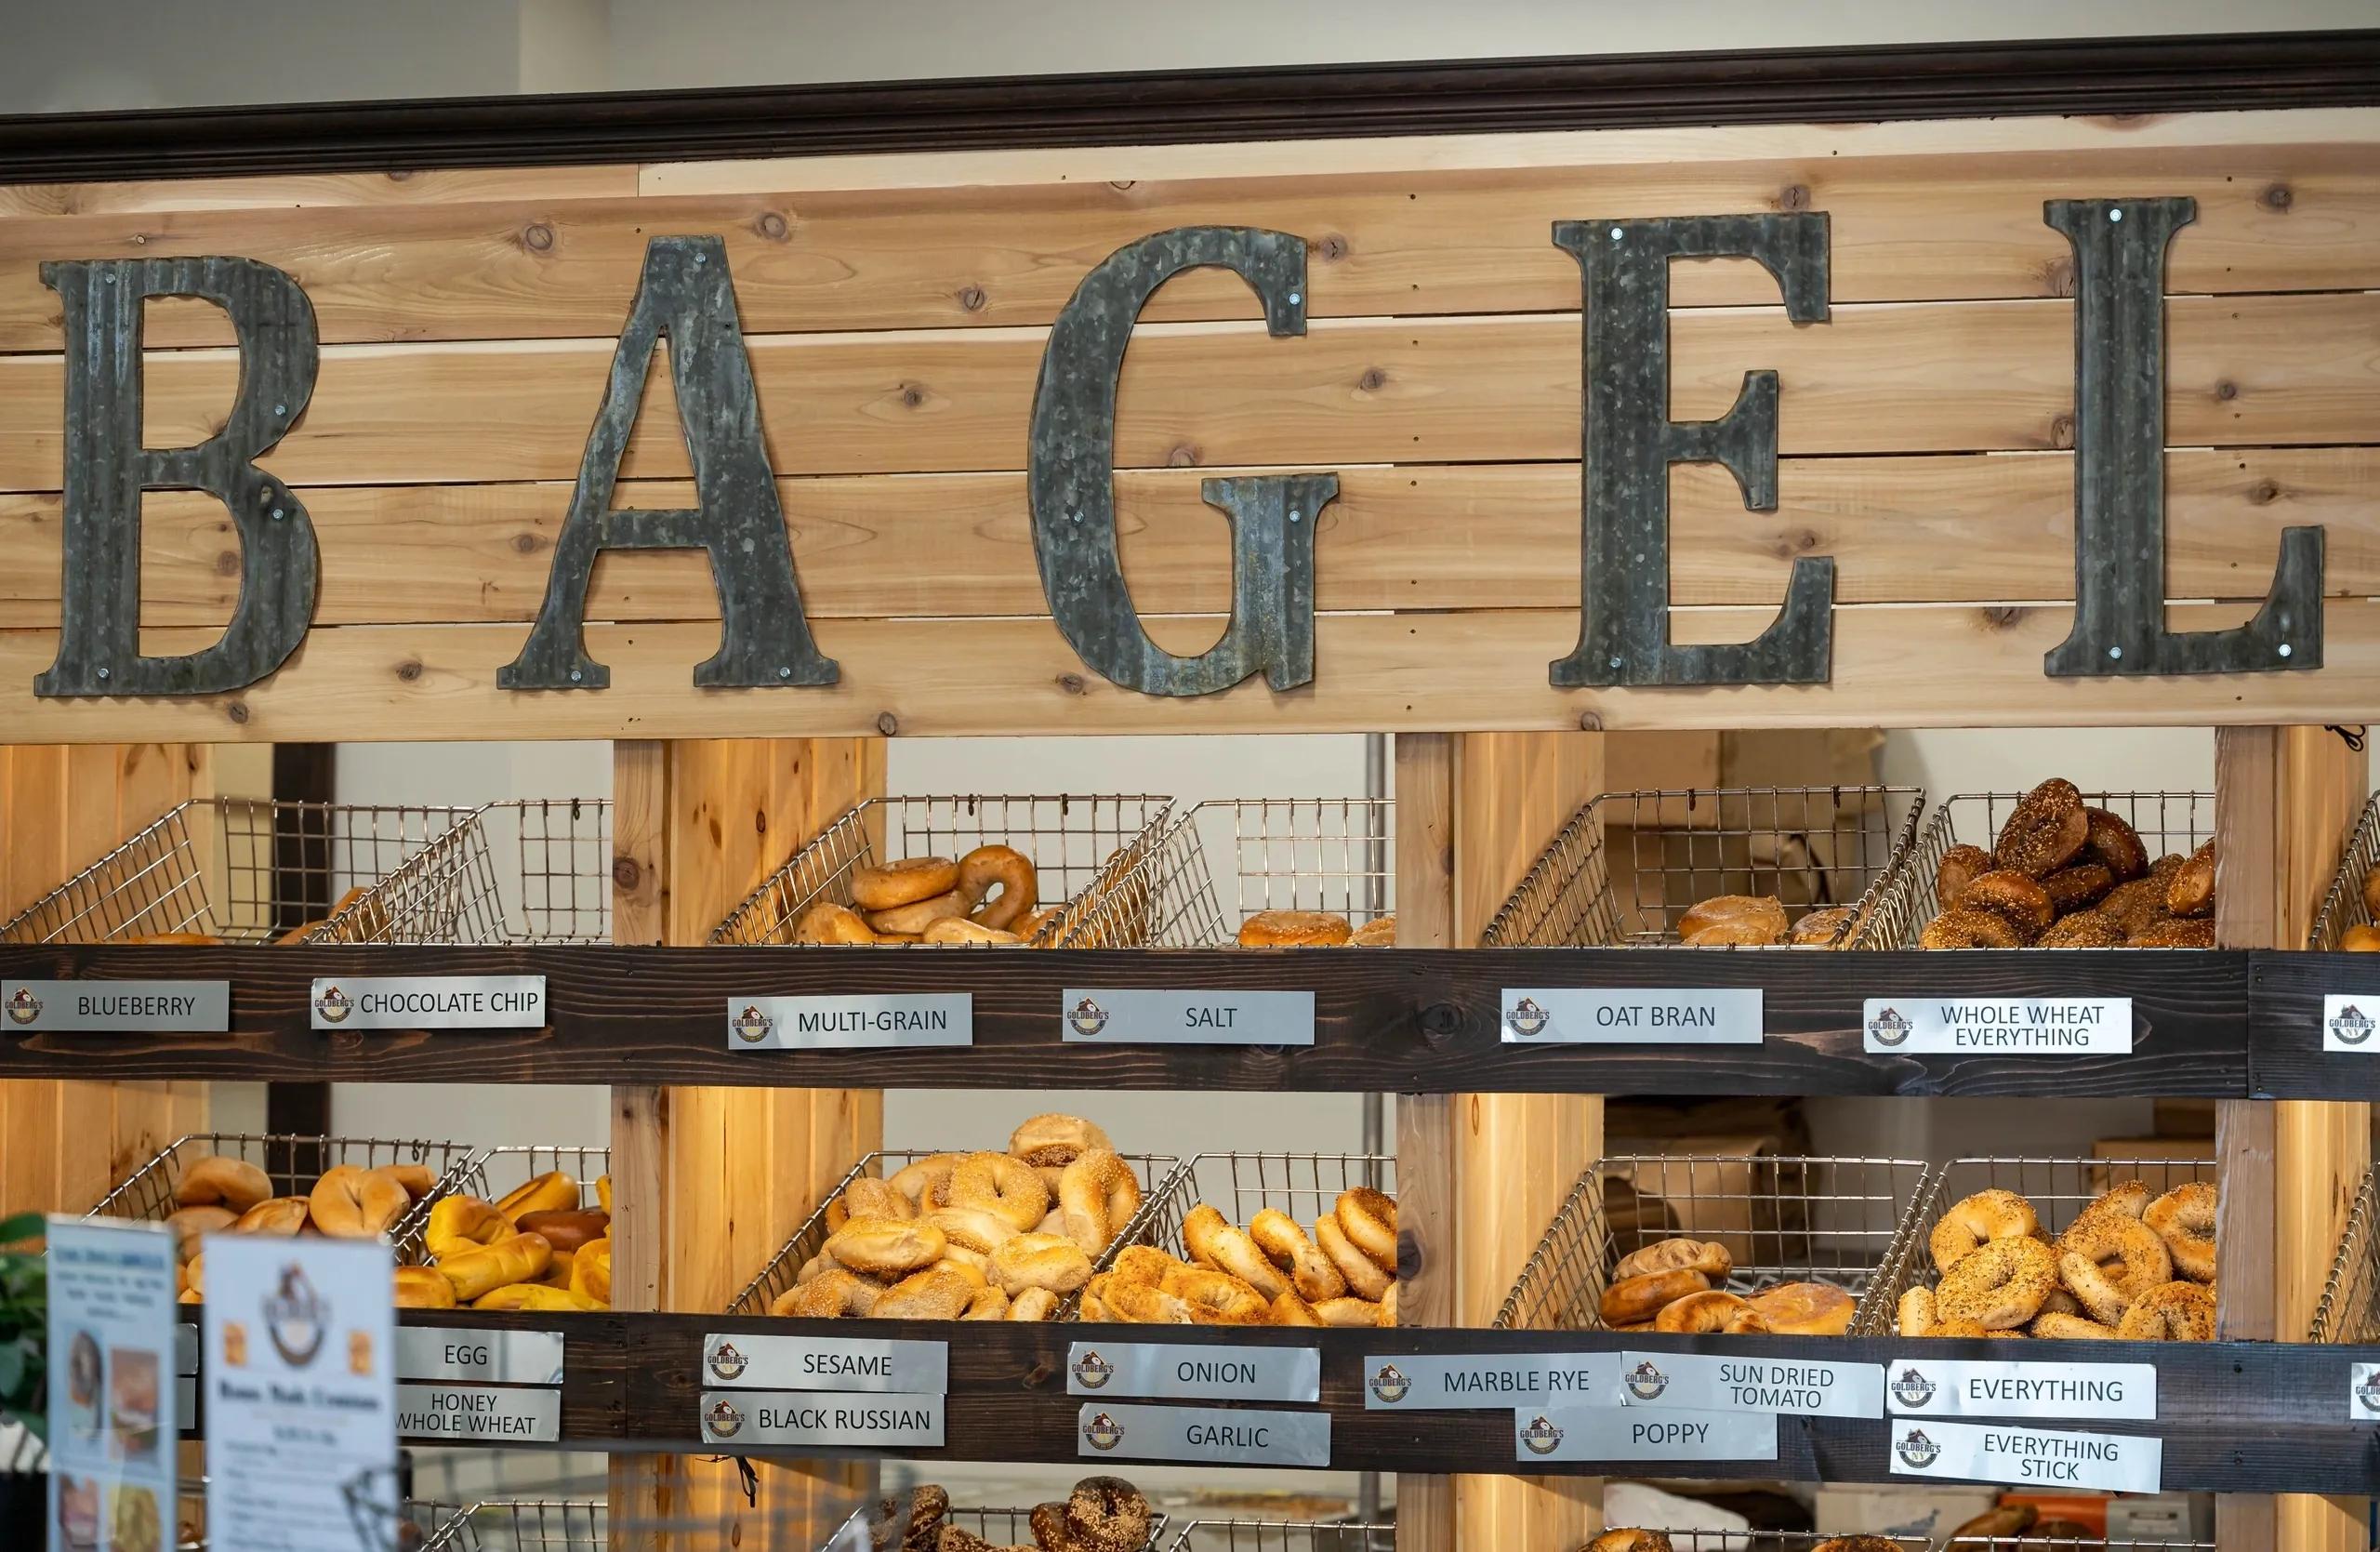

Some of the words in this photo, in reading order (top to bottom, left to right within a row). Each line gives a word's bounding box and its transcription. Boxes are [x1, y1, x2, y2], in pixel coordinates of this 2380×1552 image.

[34, 196, 2324, 697] BAGEL
[5, 1001, 44, 1009] GOLDBERG'S
[78, 997, 195, 1015] BLUEBERRY
[314, 999, 355, 1008] GOLDBERG'S
[361, 993, 483, 1013] CHOCOLATE
[491, 992, 538, 1012] CHIP
[732, 1018, 774, 1028] GOLDBERG'S
[799, 1010, 946, 1031] MULTI-GRAIN
[1066, 1011, 1109, 1020] GOLDBERG'S
[1185, 1007, 1237, 1028] SALT
[1506, 1011, 1550, 1020] GOLDBERG'S
[1596, 1006, 1643, 1027] OAT
[1651, 1006, 1715, 1027] BRAN
[1941, 1006, 2019, 1024] WHOLE
[2027, 1006, 2105, 1024] WHEAT
[2329, 1018, 2375, 1028] GOLDBERG'S
[1868, 1021, 1913, 1030] GOLDBERG'S
[1956, 1028, 2089, 1046] EVERYTHING
[444, 1345, 487, 1365] EGG
[707, 1356, 748, 1365] GOLDBERG'S
[803, 1354, 892, 1376] SESAME
[1071, 1363, 1114, 1373] GOLDBERG'S
[1177, 1361, 1256, 1384] ONION
[1368, 1378, 1411, 1387] GOLDBERG'S
[1445, 1372, 1540, 1392] MARBLE
[1549, 1371, 1590, 1391] RYE
[1624, 1373, 1670, 1385] GOLDBERG'S
[1720, 1364, 1763, 1384] SUN
[1772, 1368, 1834, 1387] DRIED
[1891, 1383, 1937, 1392] GOLDBERG'S
[1970, 1378, 2123, 1401] EVERYTHING
[431, 1393, 497, 1412] HONEY
[1730, 1386, 1821, 1408] TOMATO
[395, 1413, 462, 1431] WHOLE
[468, 1415, 536, 1434] WHEAT
[704, 1413, 746, 1422] GOLDBERG'S
[760, 1409, 827, 1429] BLACK
[836, 1410, 931, 1430] RUSSIAN
[1082, 1425, 1125, 1435] GOLDBERG'S
[1186, 1425, 1269, 1448] GARLIC
[1519, 1429, 1564, 1439] GOLDBERG'S
[1633, 1423, 1709, 1443] POPPY
[1896, 1441, 1941, 1453] GOLDBERG'S
[1985, 1434, 2119, 1461] EVERYTHING
[2020, 1459, 2079, 1480] STICK
